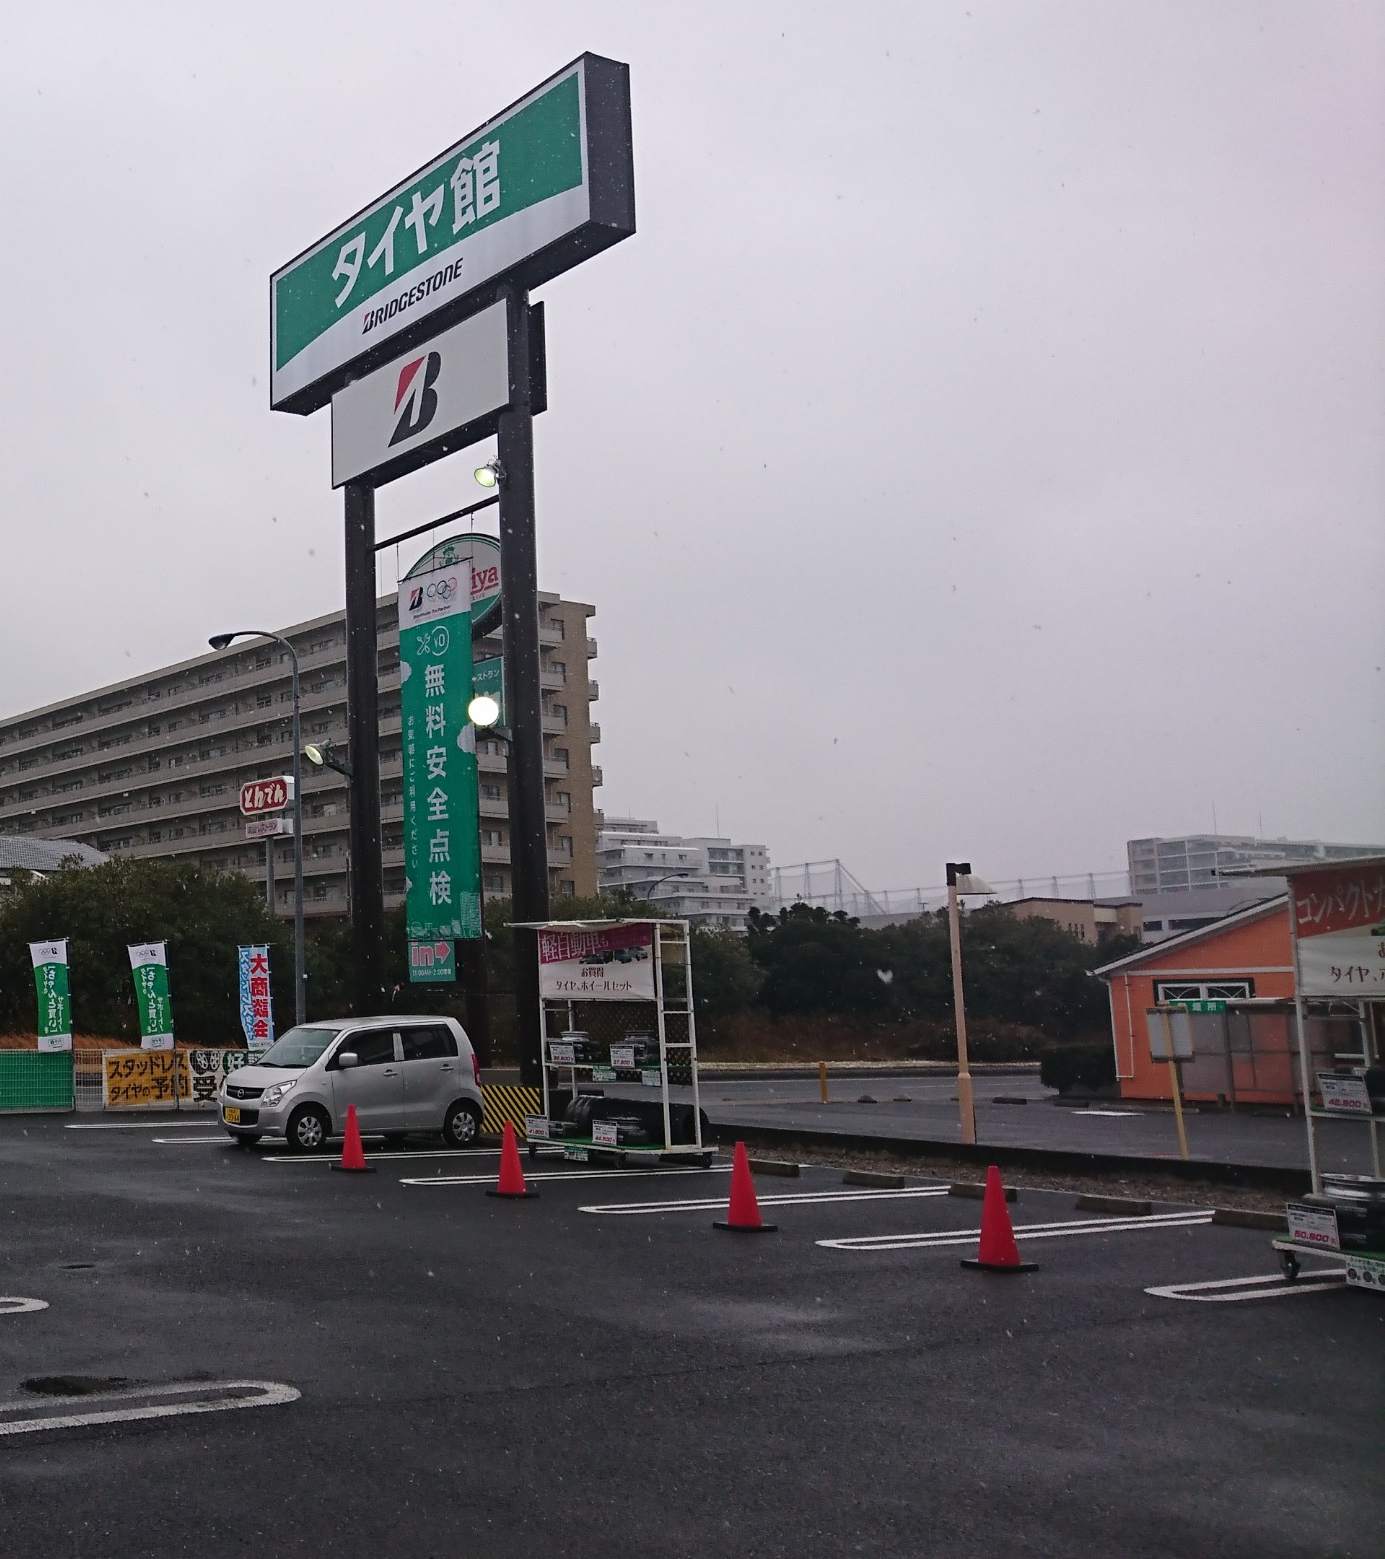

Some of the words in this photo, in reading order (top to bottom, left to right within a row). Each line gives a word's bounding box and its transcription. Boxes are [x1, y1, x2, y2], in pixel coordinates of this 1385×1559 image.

[332, 139, 501, 308] タイヤ館
[362, 257, 464, 335] BRIDGESTONE
[245, 783, 285, 808] とんでん
[424, 664, 452, 906] 無料安全点検
[411, 939, 434, 966] in
[108, 1053, 187, 1080] スタッドレス
[110, 1074, 189, 1102] タイヤの予約
[193, 1076, 226, 1102] 受
